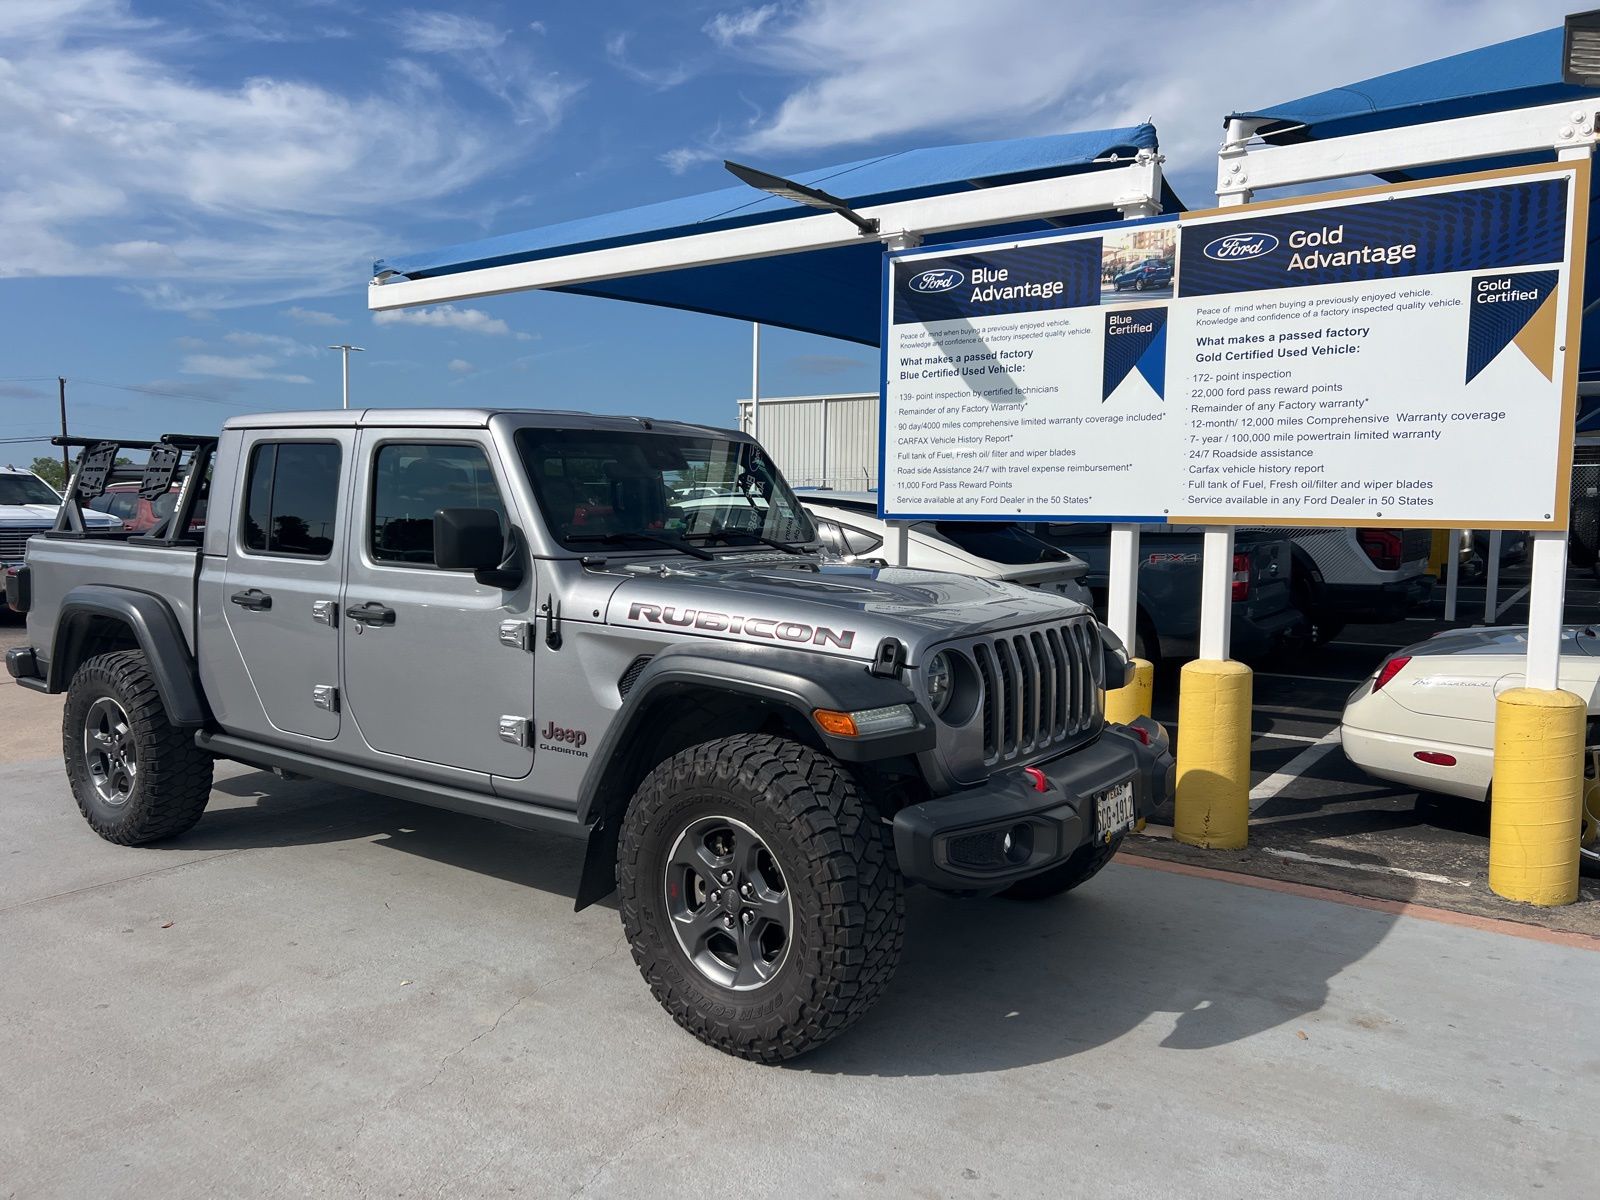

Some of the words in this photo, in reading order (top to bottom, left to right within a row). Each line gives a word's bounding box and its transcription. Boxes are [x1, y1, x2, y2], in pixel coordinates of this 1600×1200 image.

[1289, 225, 1343, 248] Gold
[1217, 235, 1263, 257] Ford
[1287, 245, 1416, 270] Advantage
[919, 271, 952, 290] Ford
[972, 268, 1008, 284] Blue
[970, 282, 1063, 302] Advantage
[1478, 279, 1511, 292] Gold
[1222, 305, 1231, 313] of
[1234, 304, 1254, 312] mind
[1255, 303, 1277, 311] when
[1279, 301, 1306, 309] buying
[1316, 295, 1360, 307] previously
[1361, 291, 1396, 303] enjoyed
[1477, 289, 1538, 303] Certified
[1109, 315, 1132, 325] Blue
[1196, 317, 1238, 326] Knowledge
[1240, 315, 1255, 323] and
[1256, 313, 1301, 321] confidence
[1302, 310, 1311, 318] of
[1320, 308, 1350, 316] factory
[1351, 304, 1394, 314] inspected
[1396, 301, 1426, 311] quality
[1108, 323, 1153, 335] Certified
[1196, 337, 1225, 346] What
[1228, 334, 1265, 344] makes
[1268, 334, 1275, 342] a
[1279, 329, 1322, 343] passed
[1326, 328, 1370, 337] factory
[900, 357, 922, 366] What
[924, 354, 954, 364] makes
[956, 355, 961, 363] a
[964, 351, 997, 364] passed
[1000, 350, 1034, 359] factory
[1195, 352, 1222, 362] Gold
[1225, 349, 1274, 360] Certified
[1277, 347, 1308, 357] Used
[900, 371, 919, 380] Blue
[921, 367, 959, 378] Certified
[962, 366, 985, 376] Used
[1215, 372, 1239, 383] point
[1242, 370, 1292, 381] inspection
[915, 392, 934, 401] point
[934, 390, 971, 399] inspection
[973, 389, 982, 398] by
[984, 387, 1013, 397] certified
[1015, 386, 1059, 395] technicians
[1191, 388, 1224, 398] 22,000
[1226, 387, 1245, 396] ford
[1247, 387, 1271, 397] pass
[1274, 384, 1309, 394] reward
[1311, 383, 1343, 394] points
[937, 406, 945, 414] of
[946, 407, 960, 415] any
[961, 405, 989, 414] Factory
[1191, 403, 1243, 413] Remainder
[1245, 402, 1255, 411] of
[1257, 403, 1276, 412] any
[1278, 401, 1317, 410] Factory
[898, 422, 908, 430] 90
[908, 421, 941, 431] day/4000
[962, 420, 1019, 430] comprehensive
[1020, 417, 1047, 425] limited
[1048, 416, 1084, 425] warranty
[1084, 415, 1124, 424] coverage
[1191, 419, 1239, 428] 12-month/
[1241, 417, 1274, 427] 12,000
[1276, 417, 1304, 425] miles
[1306, 414, 1389, 425] Comprehensive
[1396, 412, 1448, 423] Warranty
[1450, 412, 1506, 421] coverage
[897, 437, 929, 445] CARFAX
[930, 436, 956, 444] Vehicle
[957, 436, 983, 444] History
[1202, 436, 1223, 445] year
[1232, 433, 1271, 442] 100,000
[1273, 433, 1294, 441] mile
[1296, 432, 1351, 442] powertrain
[1354, 430, 1389, 439] limited
[1392, 430, 1442, 440] warranty
[1189, 449, 1210, 459] 24/7
[1212, 449, 1258, 458] Roadside
[1260, 449, 1314, 457] assistance
[917, 466, 932, 474] side
[932, 466, 972, 474] Assistance
[973, 465, 989, 473] 24/7
[991, 465, 1006, 473] with
[1008, 465, 1030, 473] travel
[1188, 465, 1220, 473] Carfax
[1222, 464, 1256, 473] vehicle
[1258, 464, 1292, 475] history
[1294, 464, 1324, 474] report
[898, 481, 920, 489] 11,000
[921, 481, 938, 489] Ford
[939, 481, 957, 489] Pass
[988, 480, 1013, 488] Points
[1188, 480, 1205, 488] Full
[1207, 480, 1228, 488] tank
[1230, 480, 1240, 489] of
[1269, 479, 1298, 488] Fresh
[1300, 480, 1338, 488] oil/filter
[1340, 480, 1361, 489] and
[1363, 480, 1393, 490] wiper
[1396, 479, 1433, 489] blades
[965, 497, 979, 505] any
[980, 496, 998, 504] Ford
[999, 496, 1025, 504] Dealer
[1036, 496, 1049, 504] the
[1050, 495, 1061, 504] 50
[1187, 495, 1223, 504] Service
[1225, 495, 1268, 504] available
[1271, 496, 1280, 504] in
[1282, 497, 1301, 506] any
[1304, 495, 1327, 505] Ford
[1330, 496, 1366, 505] Dealer
[1368, 496, 1378, 505] in
[1381, 496, 1395, 505] 50
[1398, 496, 1434, 505] States
[1149, 552, 1200, 565] FX4
[627, 602, 856, 650] RUBICON
[542, 721, 587, 747] Jeep
[539, 743, 589, 758] GLADIATOR
